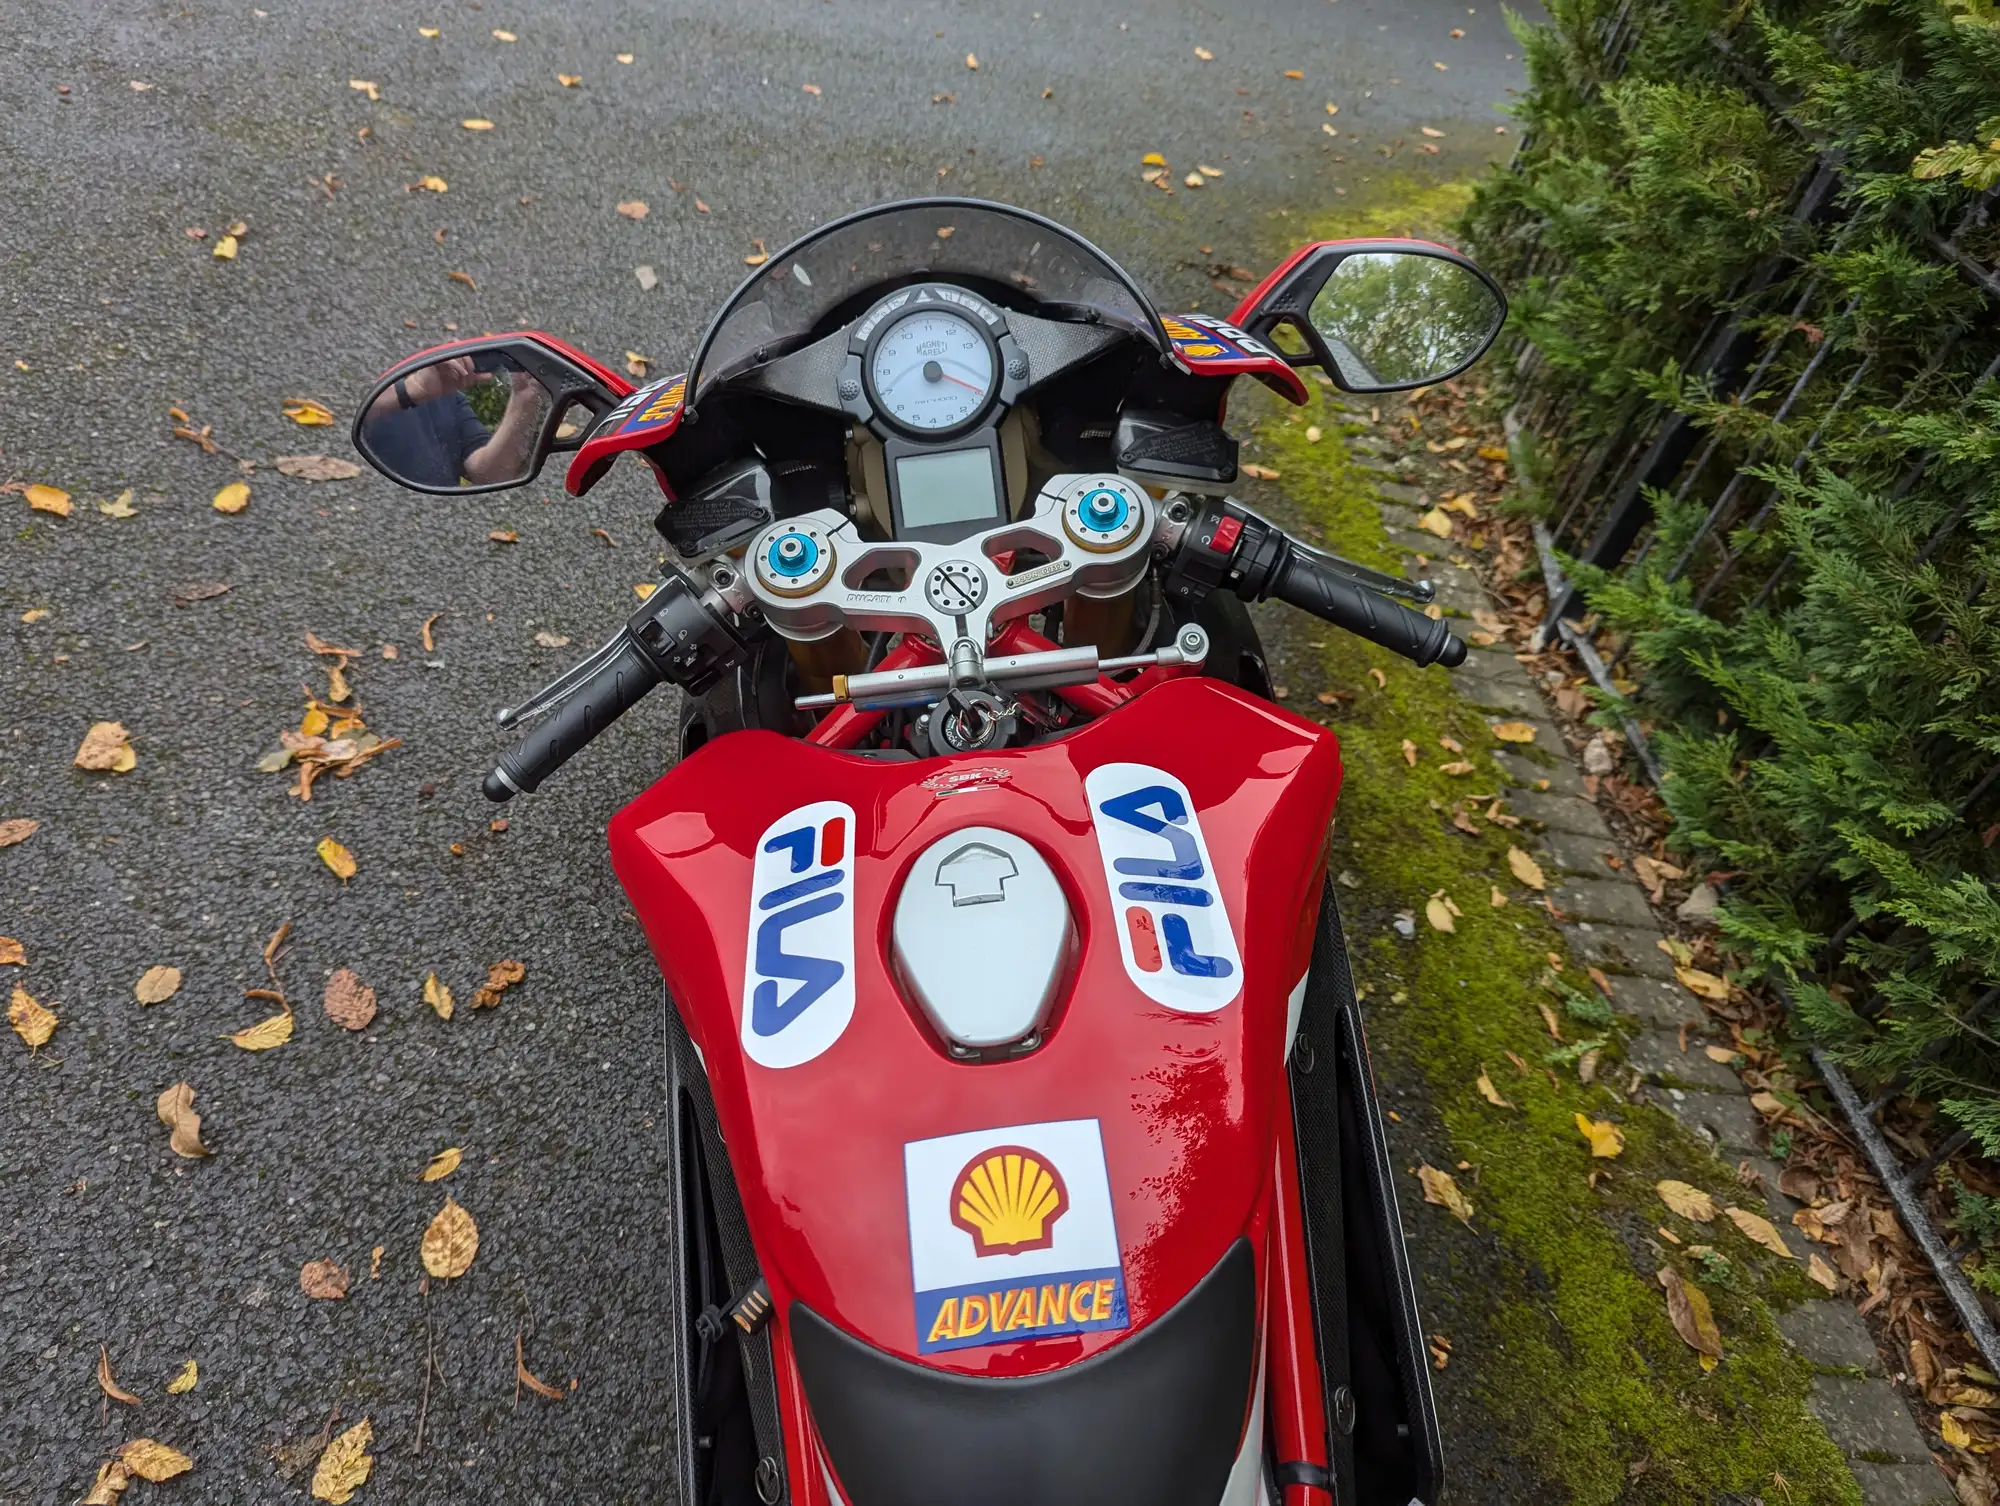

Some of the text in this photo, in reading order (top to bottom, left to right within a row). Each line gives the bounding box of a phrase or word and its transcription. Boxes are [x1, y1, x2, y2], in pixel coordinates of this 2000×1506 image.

[847, 593, 892, 603] DUCATI
[945, 728, 957, 745] LOCK
[948, 772, 982, 783] SBK
[1100, 785, 1234, 978] FILA
[752, 817, 846, 1037] FILA
[926, 1278, 1116, 1343] ADVANCE
